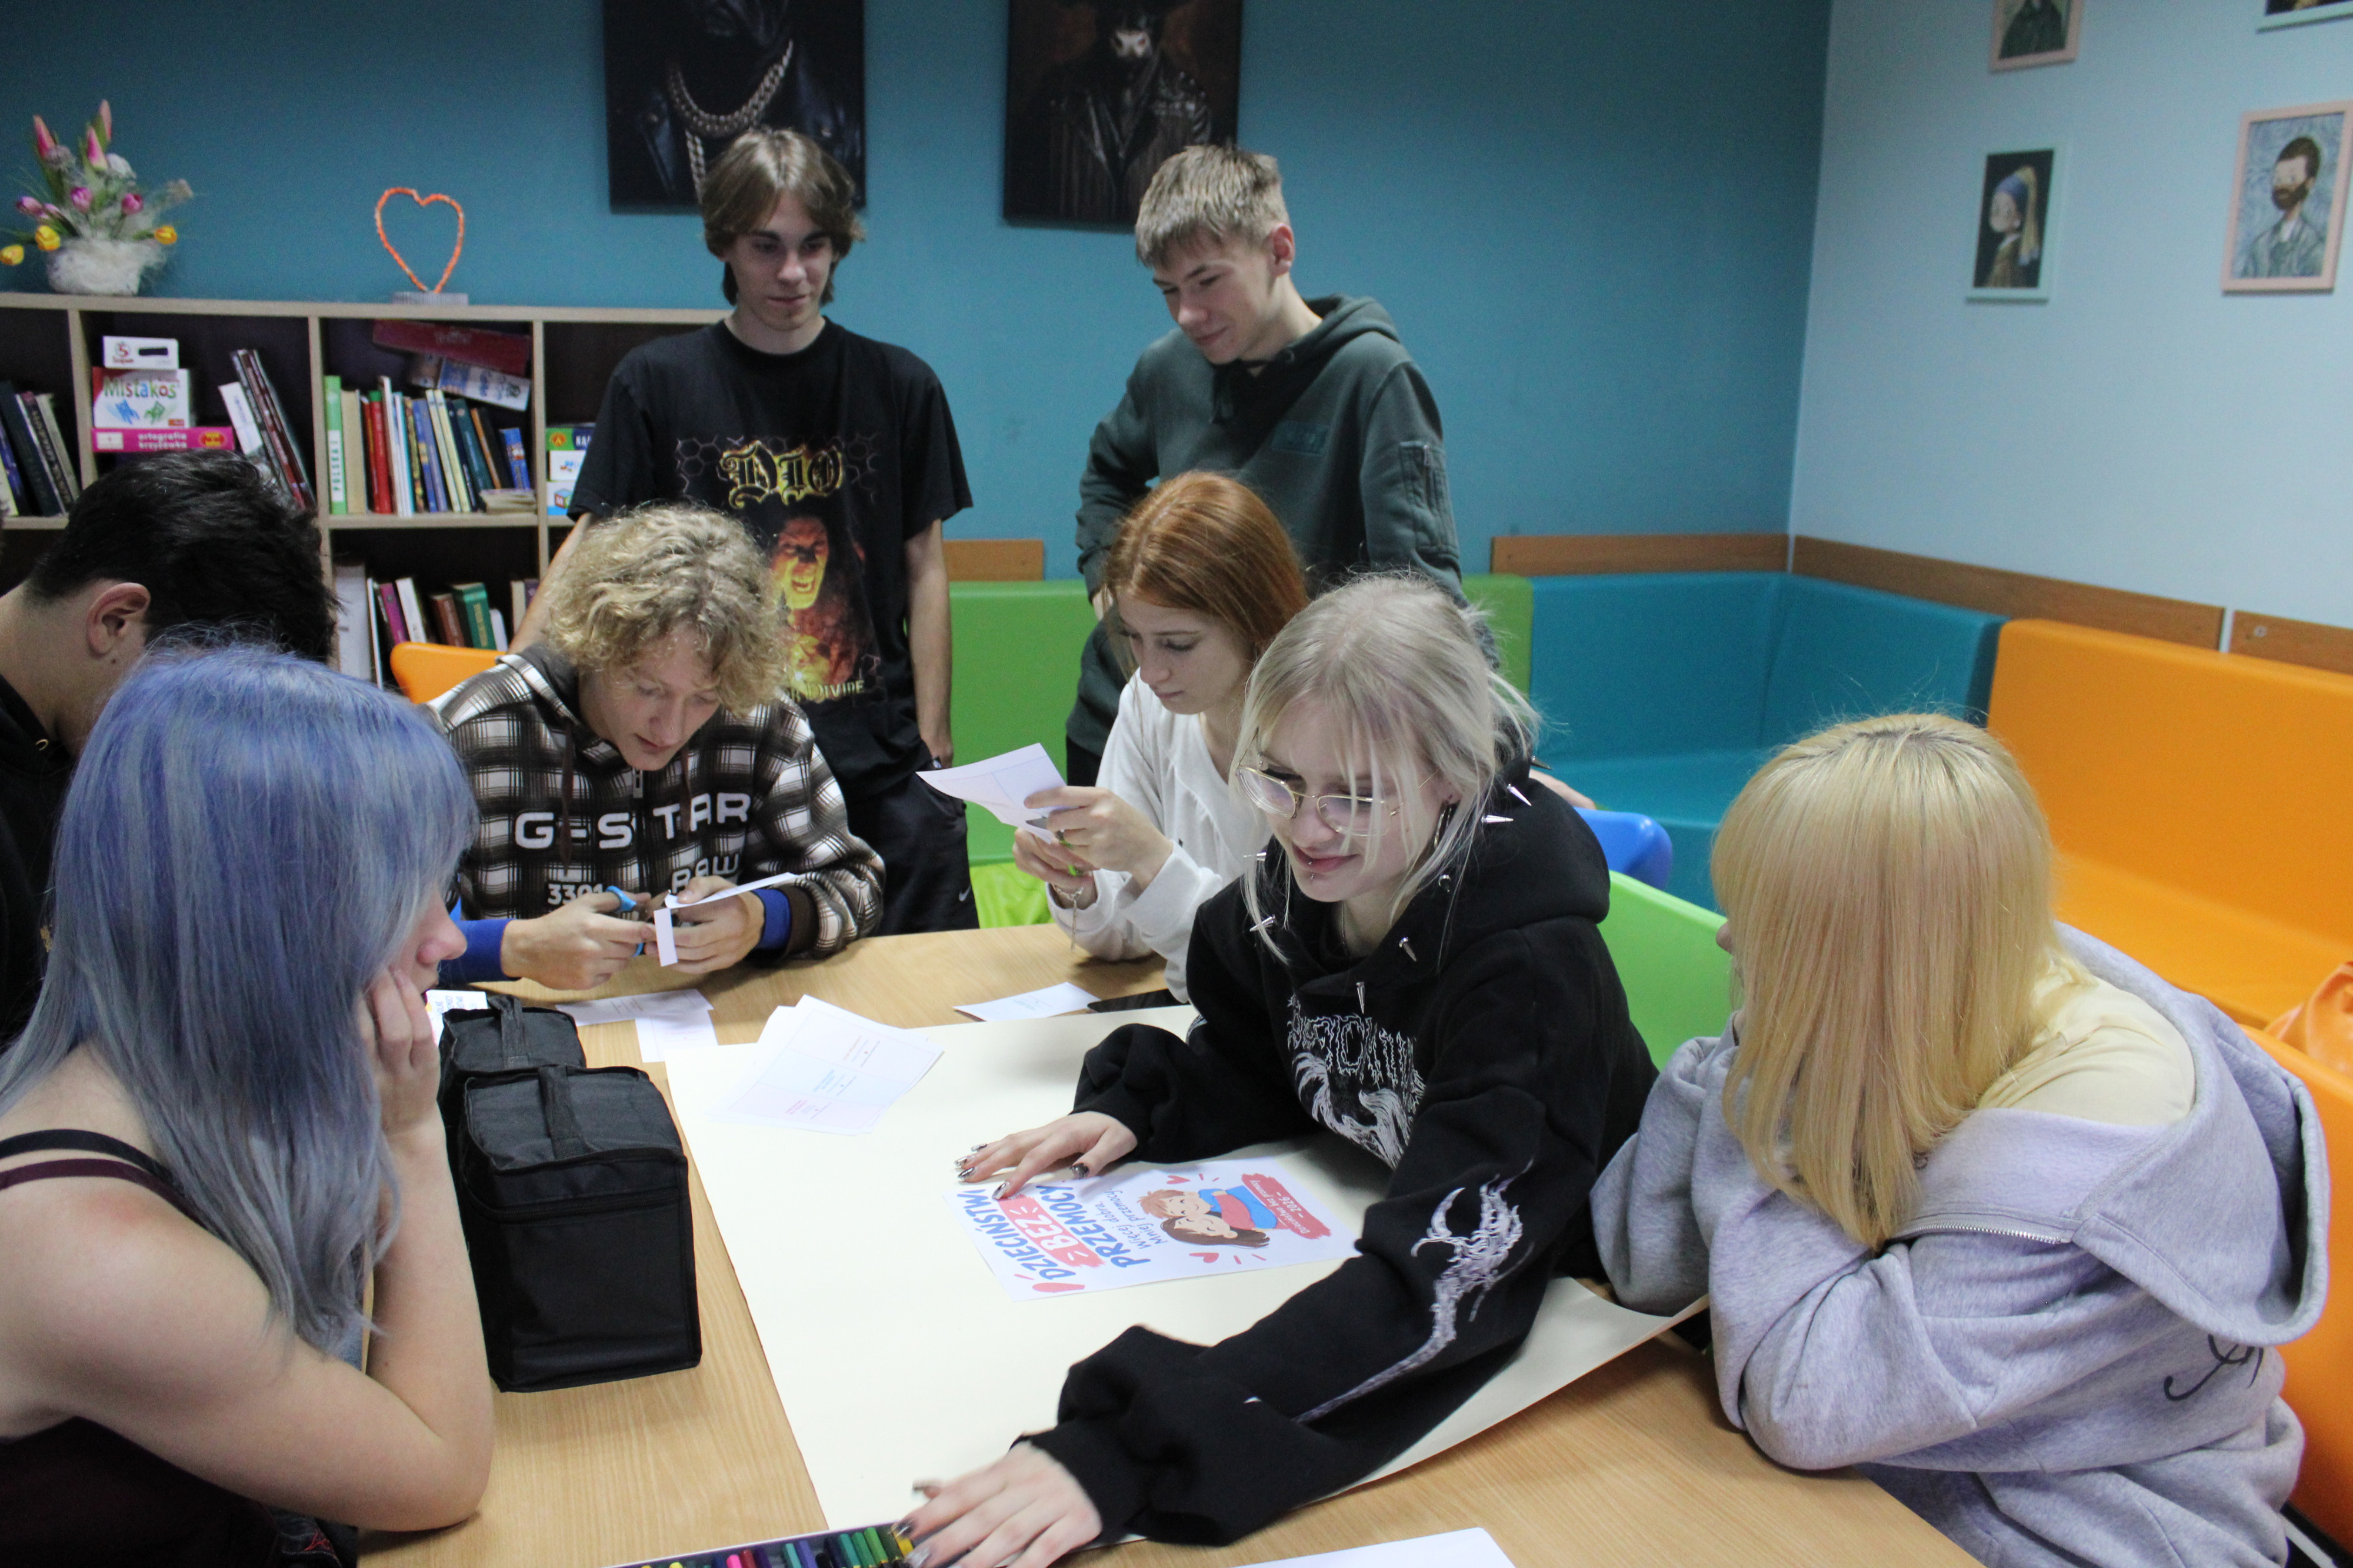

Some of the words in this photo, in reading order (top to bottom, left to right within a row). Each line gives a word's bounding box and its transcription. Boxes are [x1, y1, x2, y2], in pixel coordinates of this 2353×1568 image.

[103, 377, 176, 398] Mistakos
[719, 439, 844, 509] DIO
[1094, 1201, 1119, 1223] dobra.
[1104, 1188, 1146, 1222] przemocy.
[1014, 1214, 1079, 1250] BEZ
[1035, 1185, 1151, 1268] PRZEMOCY
[1112, 1224, 1151, 1250] Więcej
[1133, 1223, 1168, 1245] Mniej
